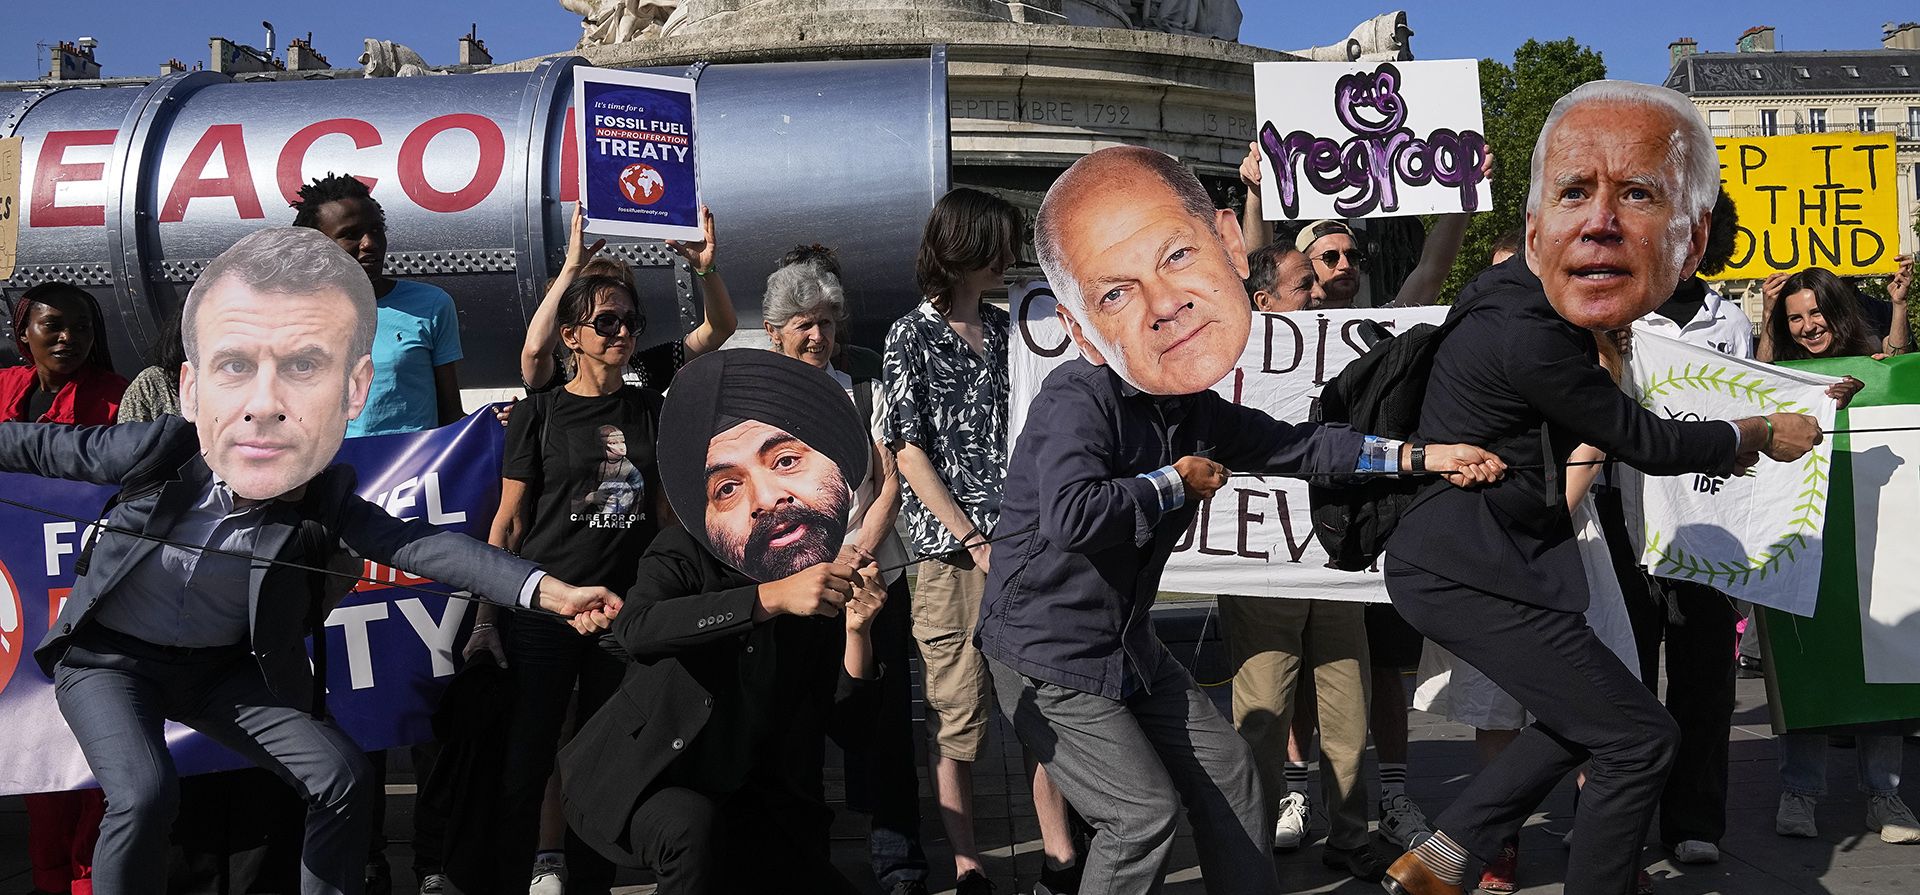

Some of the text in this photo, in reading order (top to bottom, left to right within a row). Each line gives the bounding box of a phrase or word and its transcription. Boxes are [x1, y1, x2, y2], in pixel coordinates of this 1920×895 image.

[595, 101, 606, 109] It's
[607, 103, 625, 111] time
[625, 104, 637, 112] for
[950, 99, 1130, 125] EPTEMBRE 1792
[595, 115, 688, 135] FOSSIL FUEL
[1203, 113, 1218, 132] 13
[597, 129, 687, 144] NON-PROLIFERATION
[596, 137, 689, 163] TREATY
[1811, 144, 1889, 190] IT
[618, 206, 669, 217] fossilfueltreaty.org
[1755, 185, 1863, 226] THE
[1693, 474, 1724, 496] IDF
[570, 513, 600, 522] CARE
[603, 513, 626, 522] FOR
